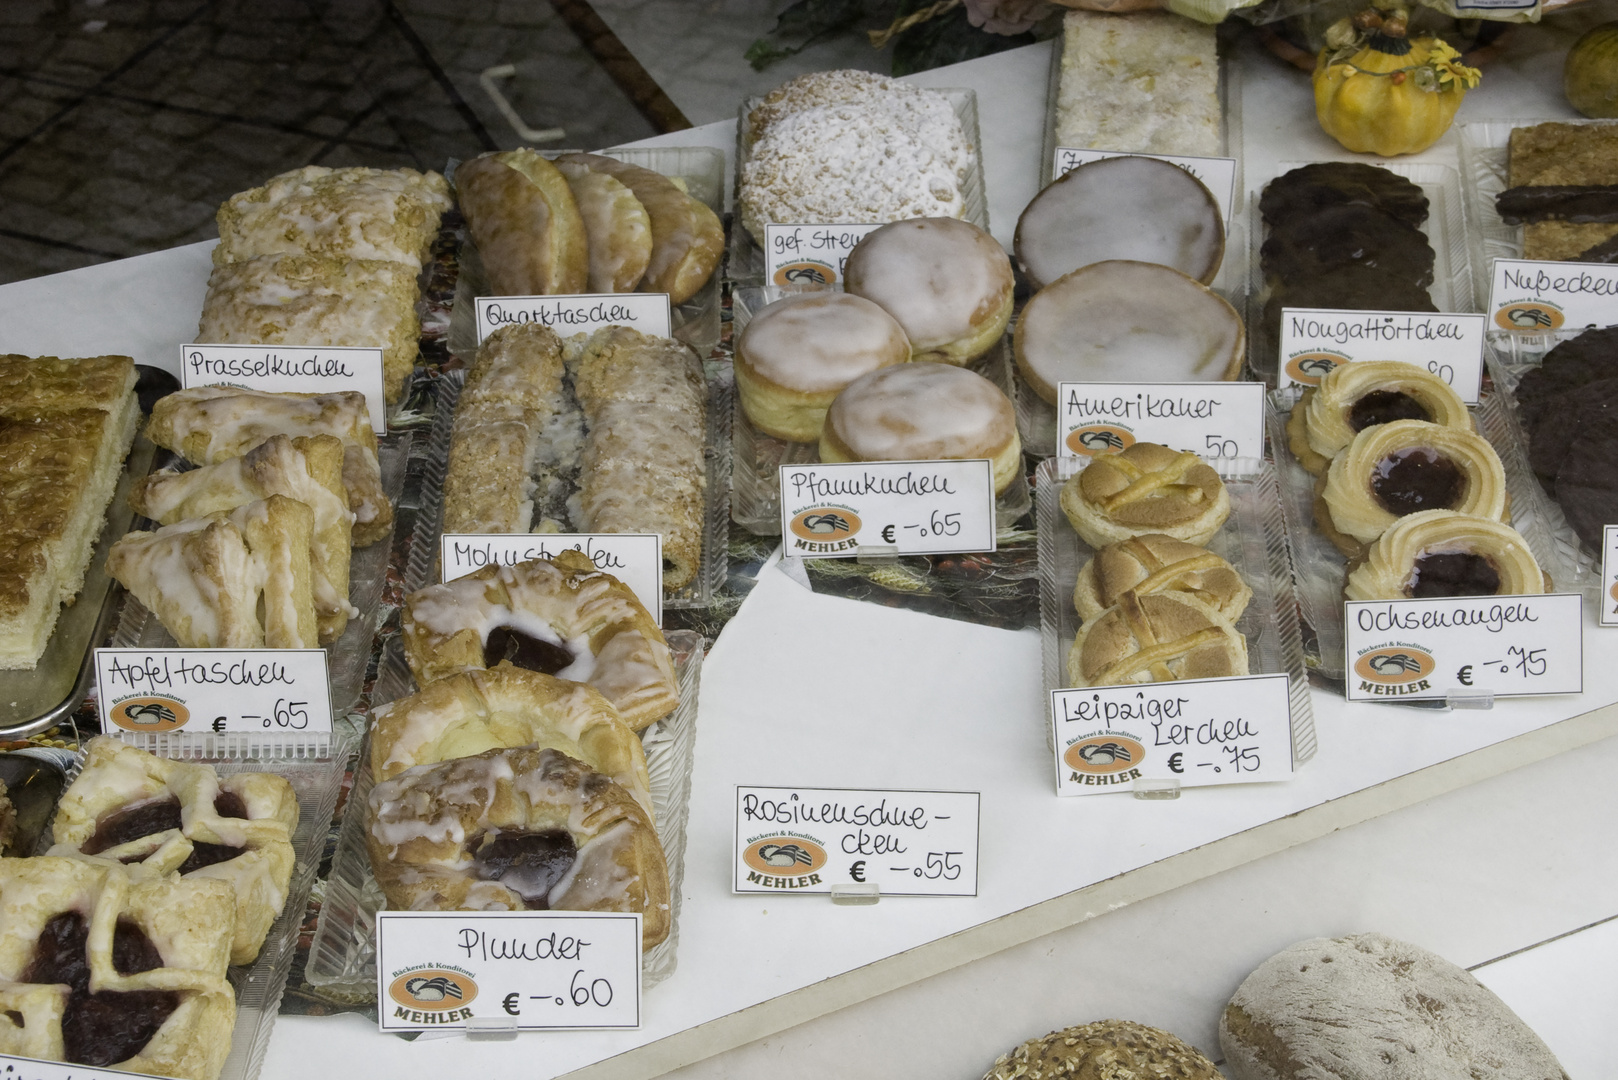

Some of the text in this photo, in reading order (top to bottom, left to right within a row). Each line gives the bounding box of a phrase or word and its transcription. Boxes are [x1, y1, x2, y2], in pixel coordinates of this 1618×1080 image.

[774, 228, 871, 254] gef. Streu
[486, 302, 638, 325] Quarktaschen
[1292, 317, 1464, 344] Nougattörtchen
[189, 351, 354, 377] Prasselkuchen
[1067, 389, 1222, 419] Amerikaner
[1068, 420, 1096, 432] Bäckerei
[1102, 419, 1135, 433] Konditorei
[790, 471, 957, 503] Pfannkuchen
[792, 503, 820, 516] Bäckerei
[827, 501, 860, 515] Konditorei
[794, 537, 860, 553] MEHLER
[881, 525, 896, 544] €
[1357, 603, 1539, 633] Ochsenaugen
[1356, 641, 1388, 656] Bäckerei
[1396, 640, 1434, 655] Konditorei
[108, 656, 295, 691] Apfeltaschen
[1456, 665, 1474, 686] €
[111, 692, 142, 706] Bäckerei
[150, 690, 187, 705] Konditorei
[1358, 679, 1432, 696] MEHLER
[1063, 692, 1189, 728] Leipziger
[1065, 730, 1097, 746] Bäckerei
[1105, 729, 1143, 743] Konditorei
[1153, 718, 1259, 746] Lerchen
[1167, 752, 1185, 774] €
[1069, 768, 1143, 786] MEHLER
[746, 831, 779, 845] Bäckerei
[787, 830, 826, 847] Konditorei
[841, 828, 908, 855] cken
[746, 871, 823, 889] MEHLER
[849, 860, 866, 883] €
[458, 928, 592, 961] Plunder
[391, 963, 427, 979] Bäckerei
[435, 962, 477, 979] Konditorei
[393, 1006, 475, 1024] MEHLER
[502, 992, 520, 1016] €
